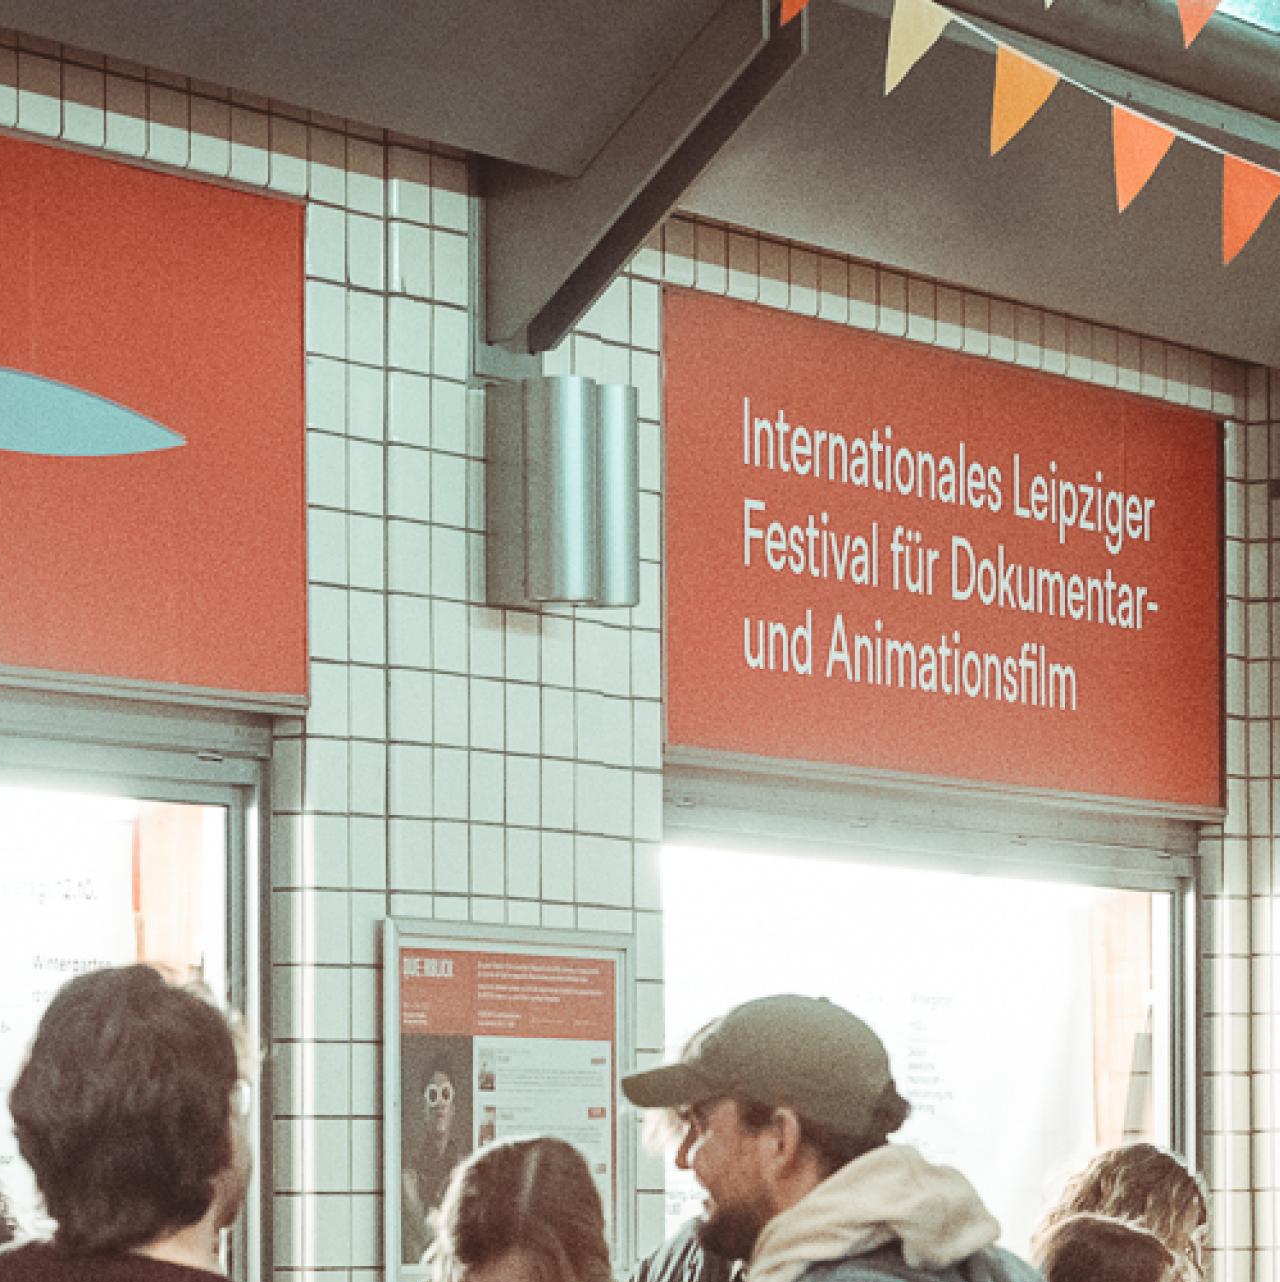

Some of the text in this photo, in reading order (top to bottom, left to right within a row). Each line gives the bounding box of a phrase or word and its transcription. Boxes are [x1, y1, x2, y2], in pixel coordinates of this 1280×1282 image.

[743, 396, 1156, 555] Internationales Leipziger
[743, 497, 1159, 629] Festival für Dokumentar-
[743, 609, 1077, 711] und Animationsfilm
